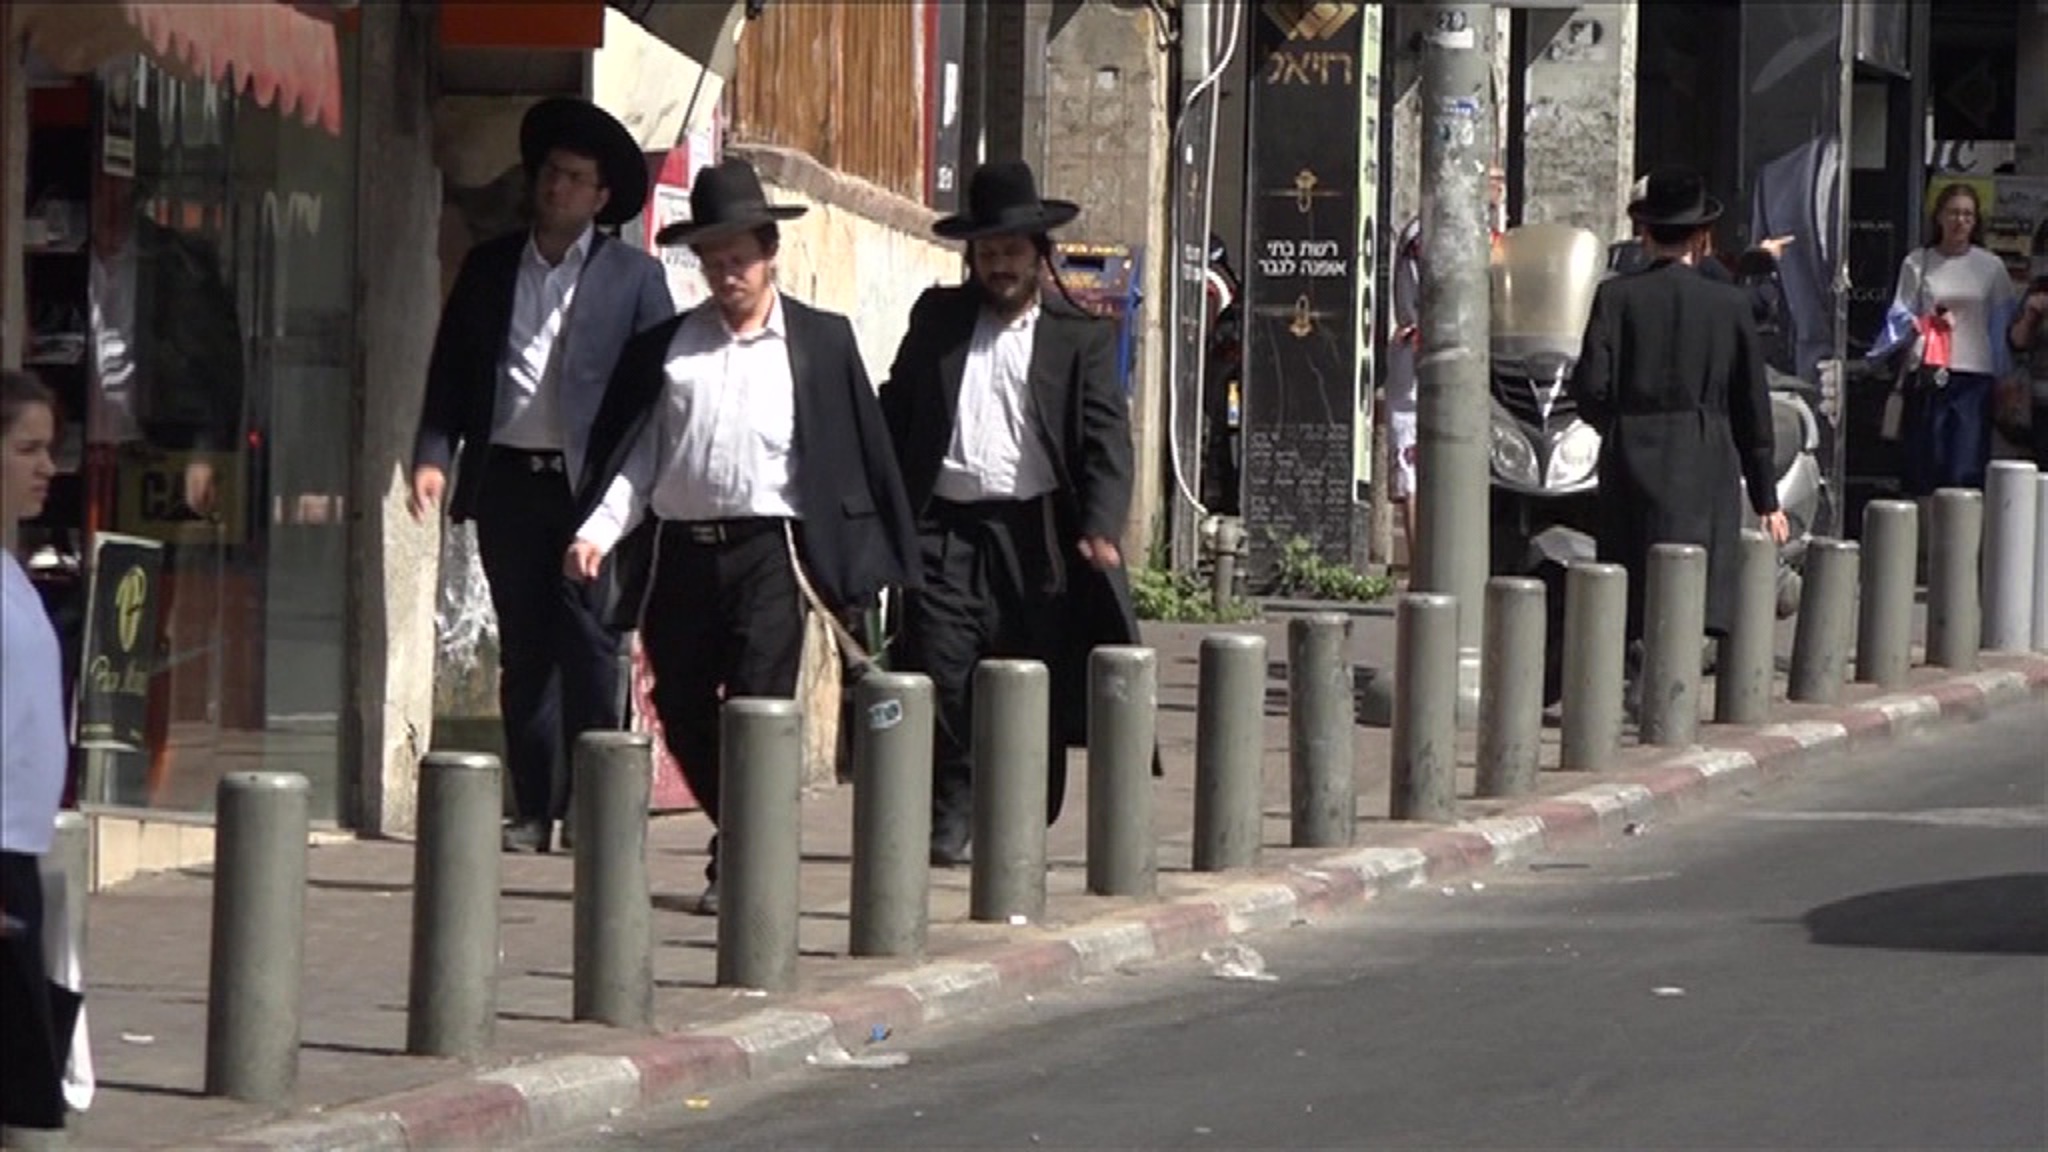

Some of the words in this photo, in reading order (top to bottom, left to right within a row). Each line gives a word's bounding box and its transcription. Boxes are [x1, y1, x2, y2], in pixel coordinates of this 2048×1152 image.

[1267, 240, 1295, 256] בתי
[1299, 240, 1338, 256] רשת
[1258, 257, 1297, 276] לגבר
[1300, 259, 1347, 276] אופנה
